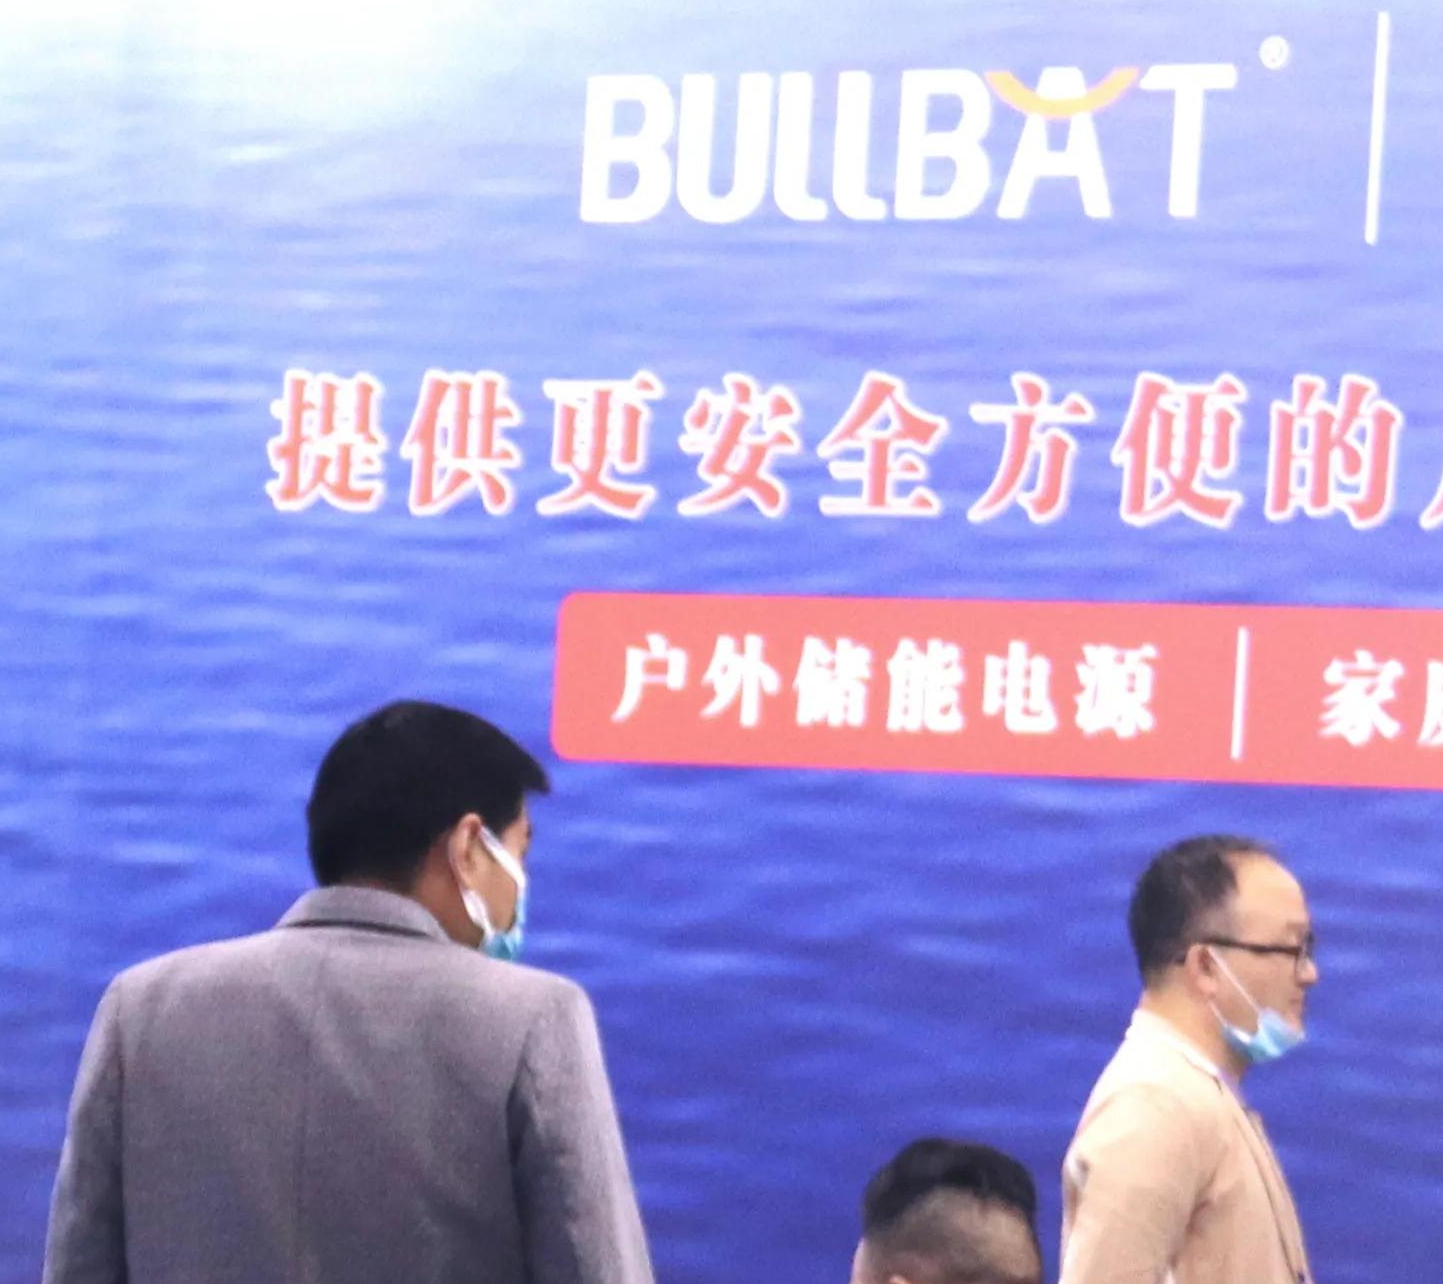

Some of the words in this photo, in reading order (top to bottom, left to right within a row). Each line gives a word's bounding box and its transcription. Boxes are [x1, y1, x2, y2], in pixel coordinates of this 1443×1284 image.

[578, 62, 1238, 224] BULLBAT
[610, 632, 1162, 740] 户外储能电源
